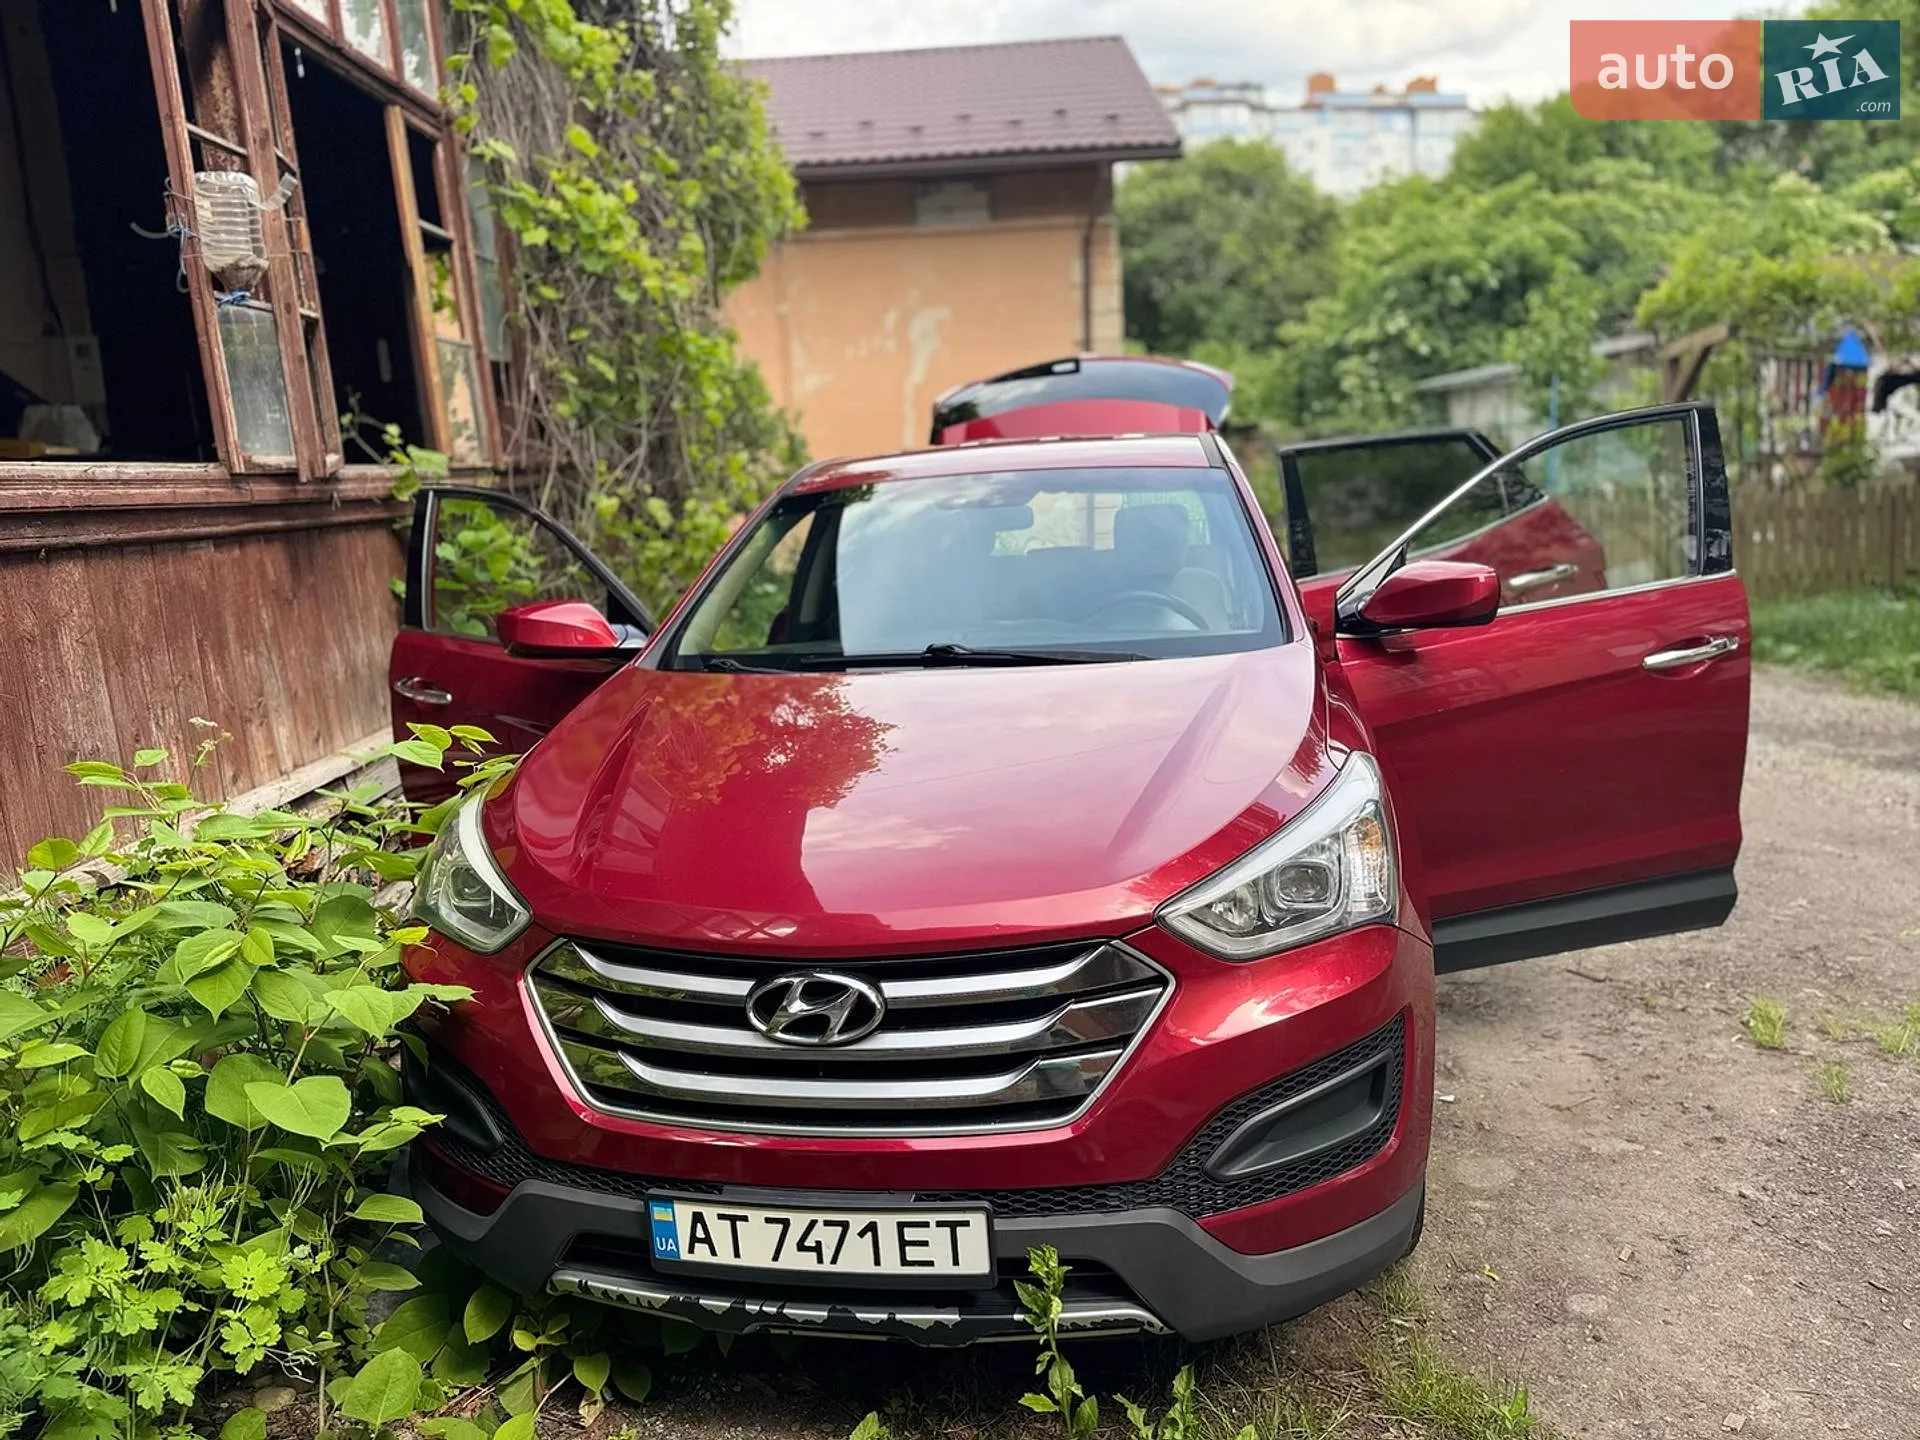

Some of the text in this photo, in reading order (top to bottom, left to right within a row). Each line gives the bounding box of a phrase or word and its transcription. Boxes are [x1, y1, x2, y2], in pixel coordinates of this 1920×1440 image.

[656, 1237, 678, 1252] UA
[687, 1211, 971, 1267] AT 7471 ET
